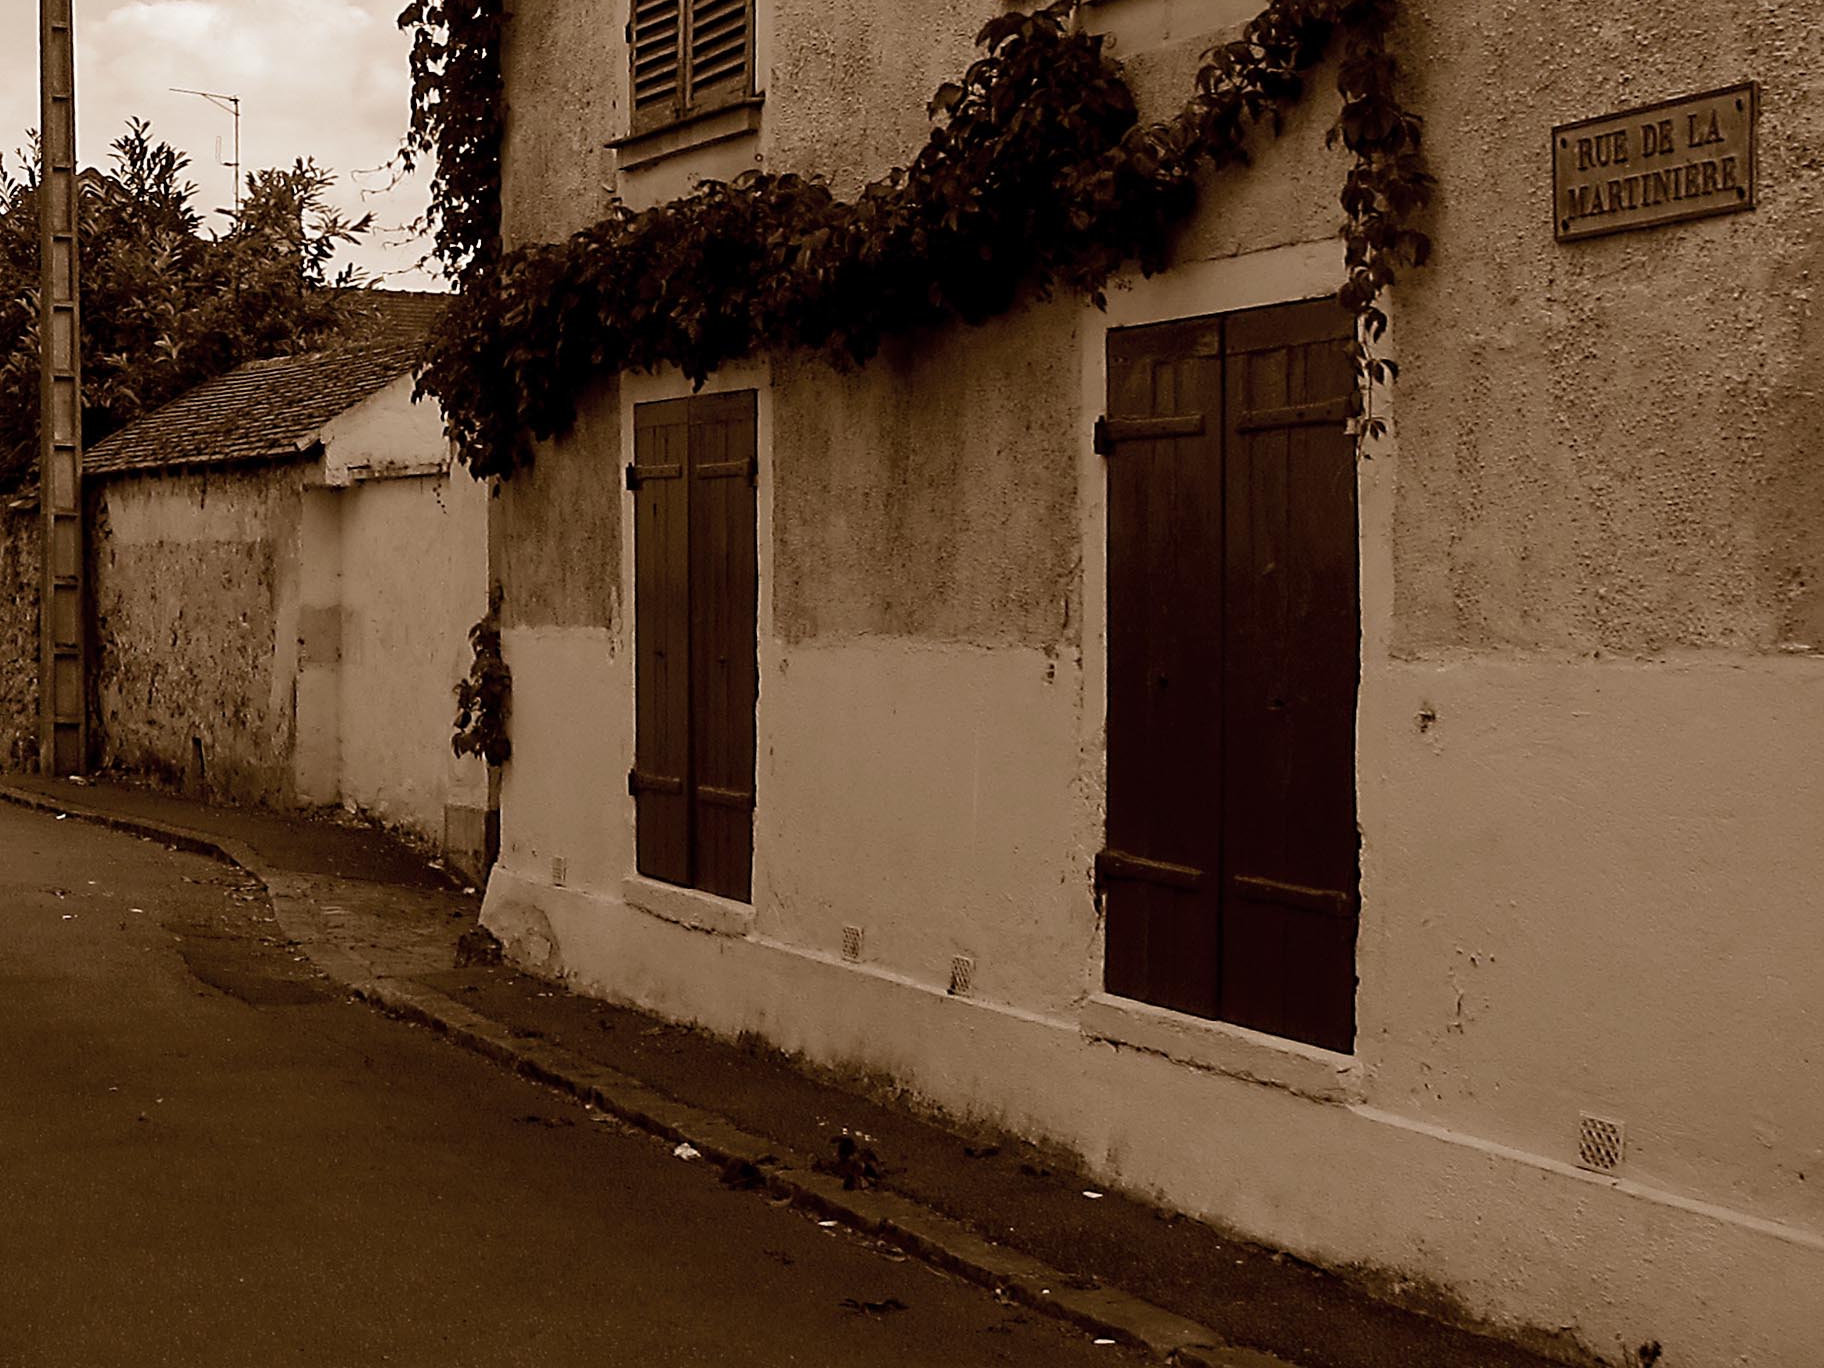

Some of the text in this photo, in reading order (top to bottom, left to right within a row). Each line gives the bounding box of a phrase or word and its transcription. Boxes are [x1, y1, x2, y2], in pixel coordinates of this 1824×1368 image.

[1577, 109, 1725, 171] RUE DE LA
